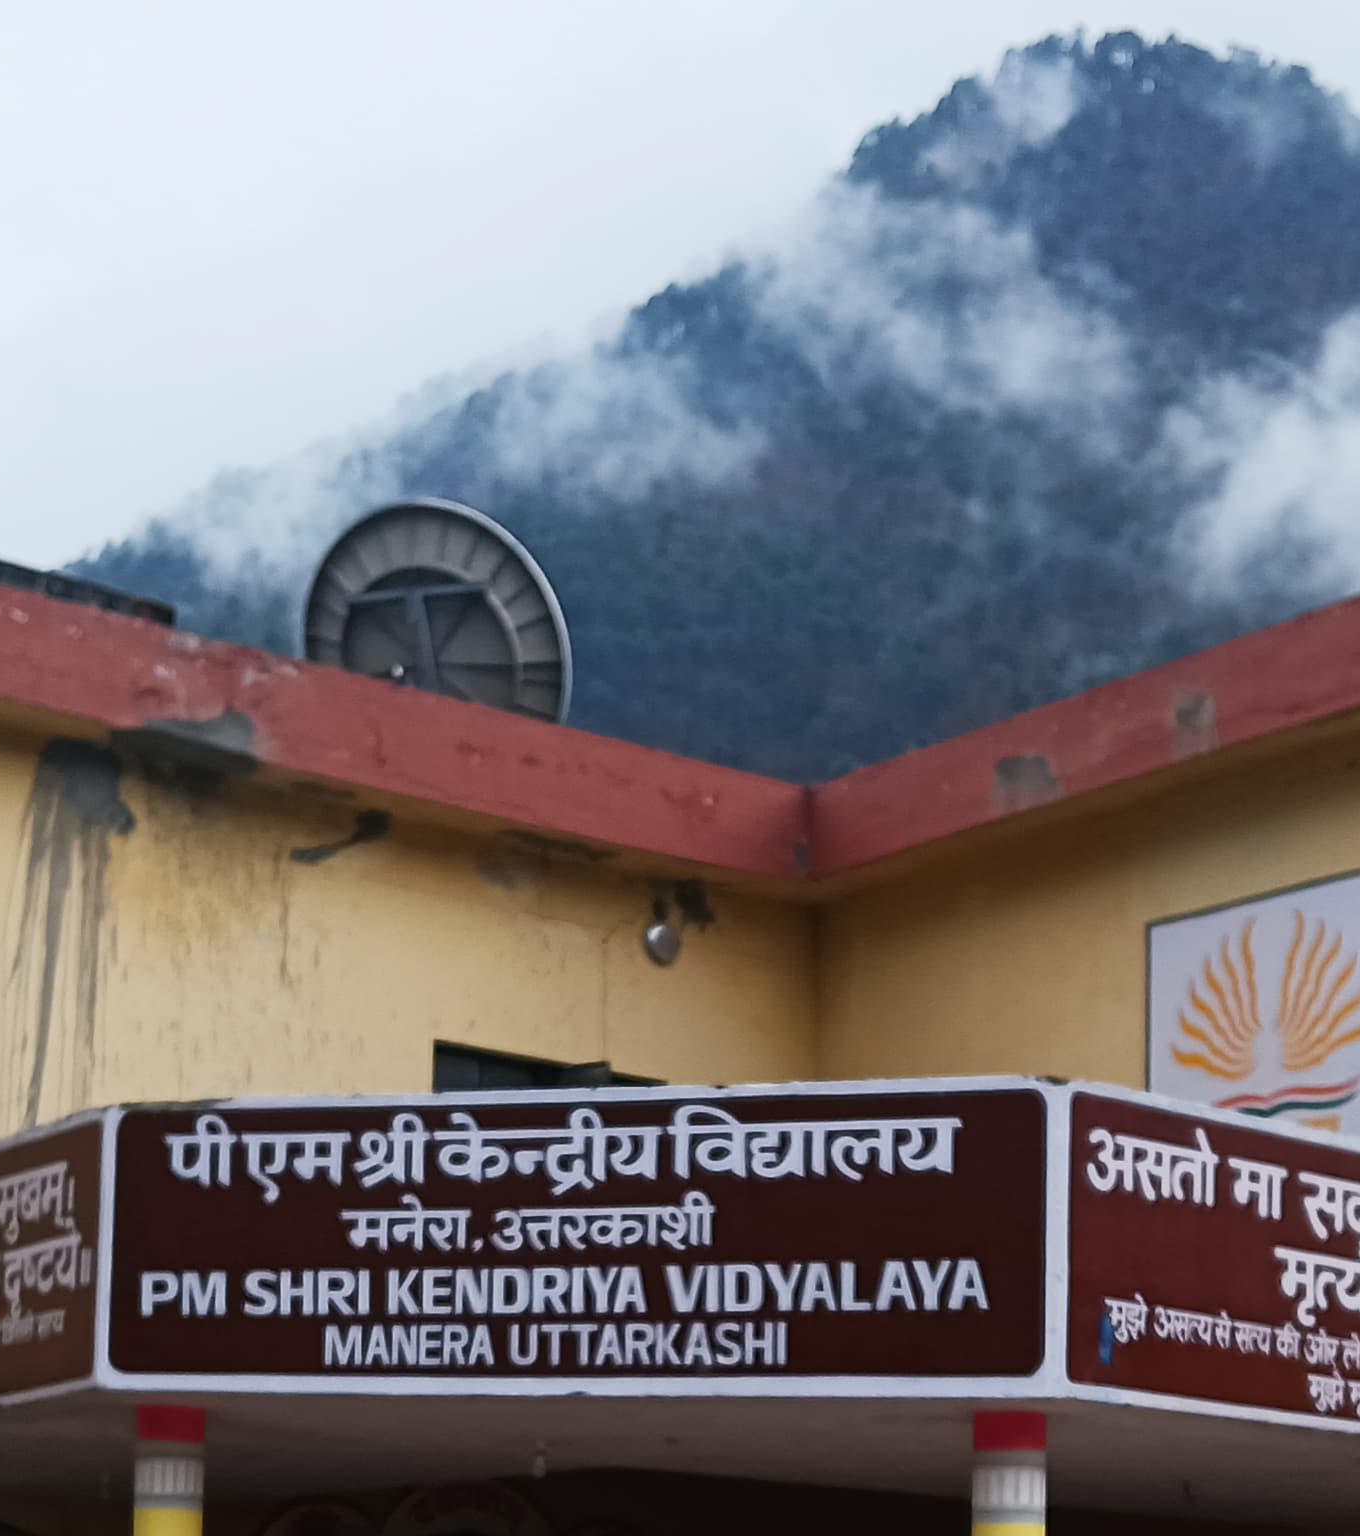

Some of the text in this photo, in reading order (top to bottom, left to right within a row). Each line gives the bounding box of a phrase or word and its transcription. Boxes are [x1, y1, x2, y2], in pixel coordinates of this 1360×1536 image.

[164, 1104, 964, 1204] पी एम श्री केन्द्रीय विद्यालय
[1086, 1128, 1218, 1208] असतो
[1228, 1157, 1288, 1221] मा
[140, 1259, 989, 1317] PM SHRI KENDRIYA VIDYALAYA
[323, 1320, 788, 1367] MANERA UTTARKASHI
[1104, 1293, 1147, 1344] मुझे
[1153, 1305, 1214, 1348] असत्य
[1214, 1311, 1234, 1349] से
[1234, 1320, 1272, 1356] सत्य
[1274, 1321, 1302, 1360] की
[1307, 1372, 1345, 1412] मुझे
